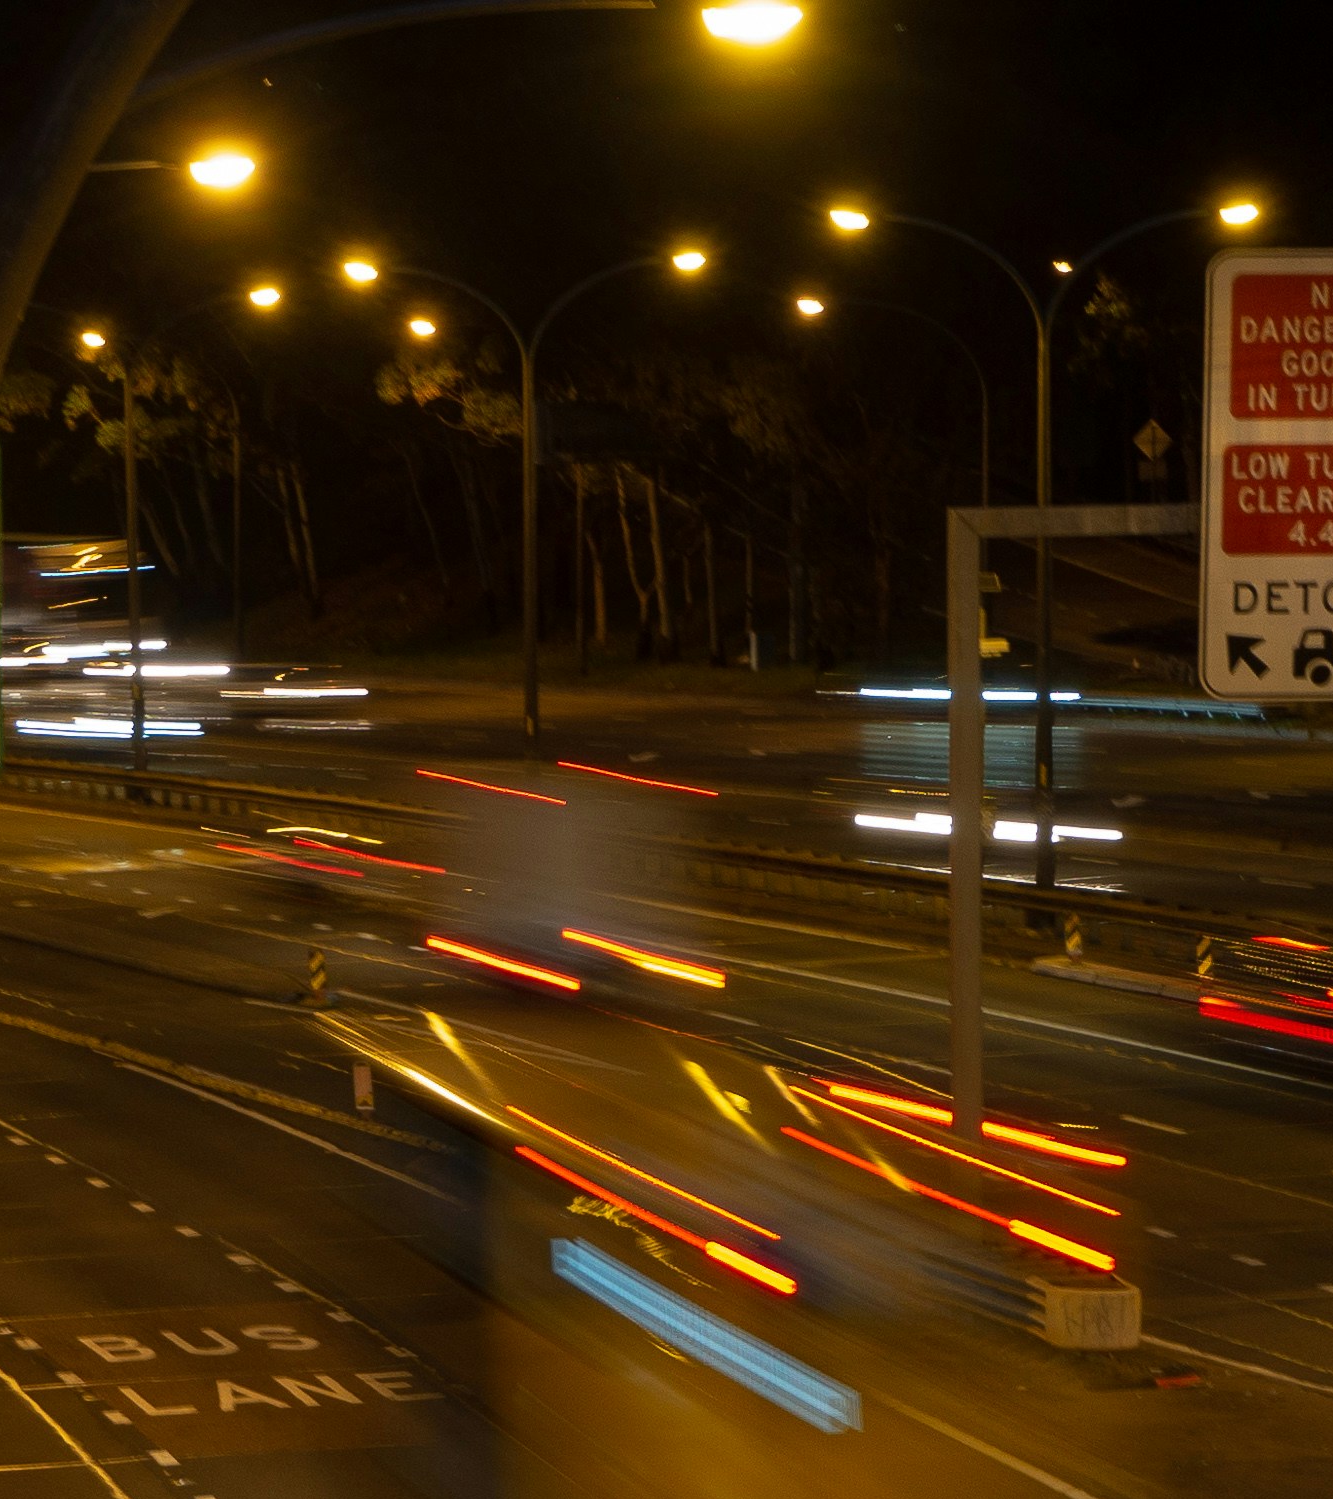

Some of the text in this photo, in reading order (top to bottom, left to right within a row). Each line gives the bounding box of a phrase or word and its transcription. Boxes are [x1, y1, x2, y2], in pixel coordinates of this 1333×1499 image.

[1249, 385, 1276, 411] IN
[1233, 452, 1290, 479] LOW
[78, 1326, 317, 1362] BUS
[120, 1371, 446, 1417] LANE
